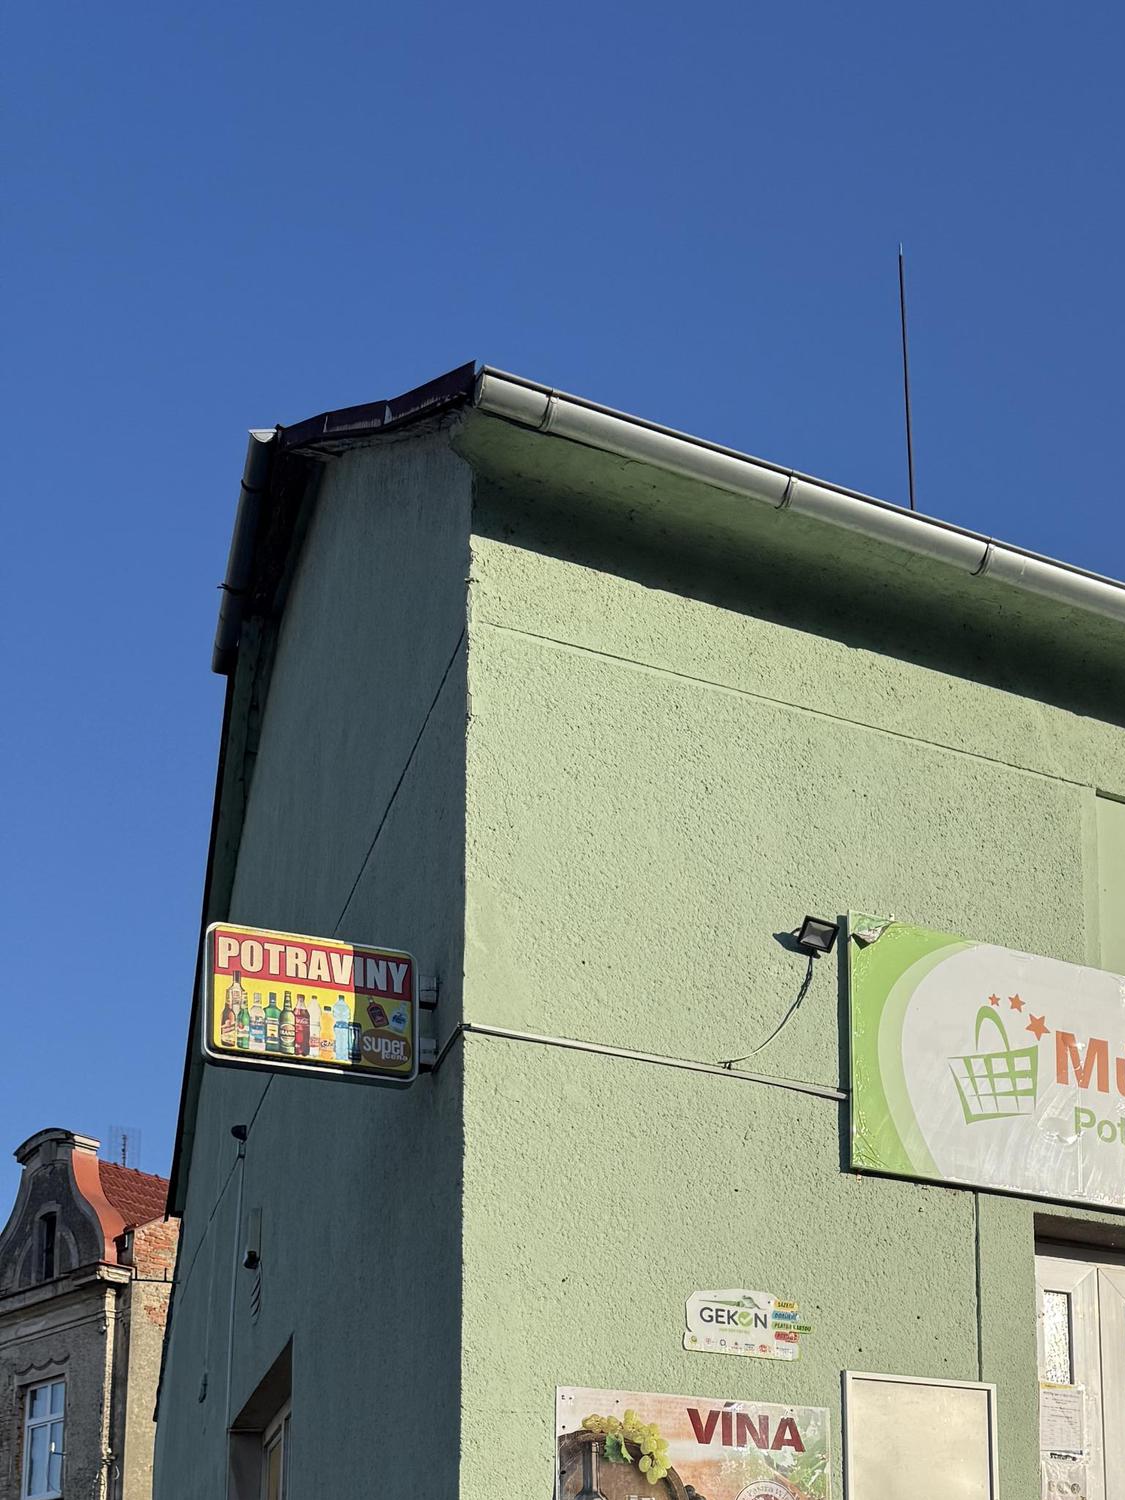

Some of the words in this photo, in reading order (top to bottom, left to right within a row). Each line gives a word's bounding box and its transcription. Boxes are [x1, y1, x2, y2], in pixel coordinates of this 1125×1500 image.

[217, 936, 409, 994] POTRAVINY
[363, 1035, 406, 1060] super
[686, 1401, 806, 1453] VÍNA
